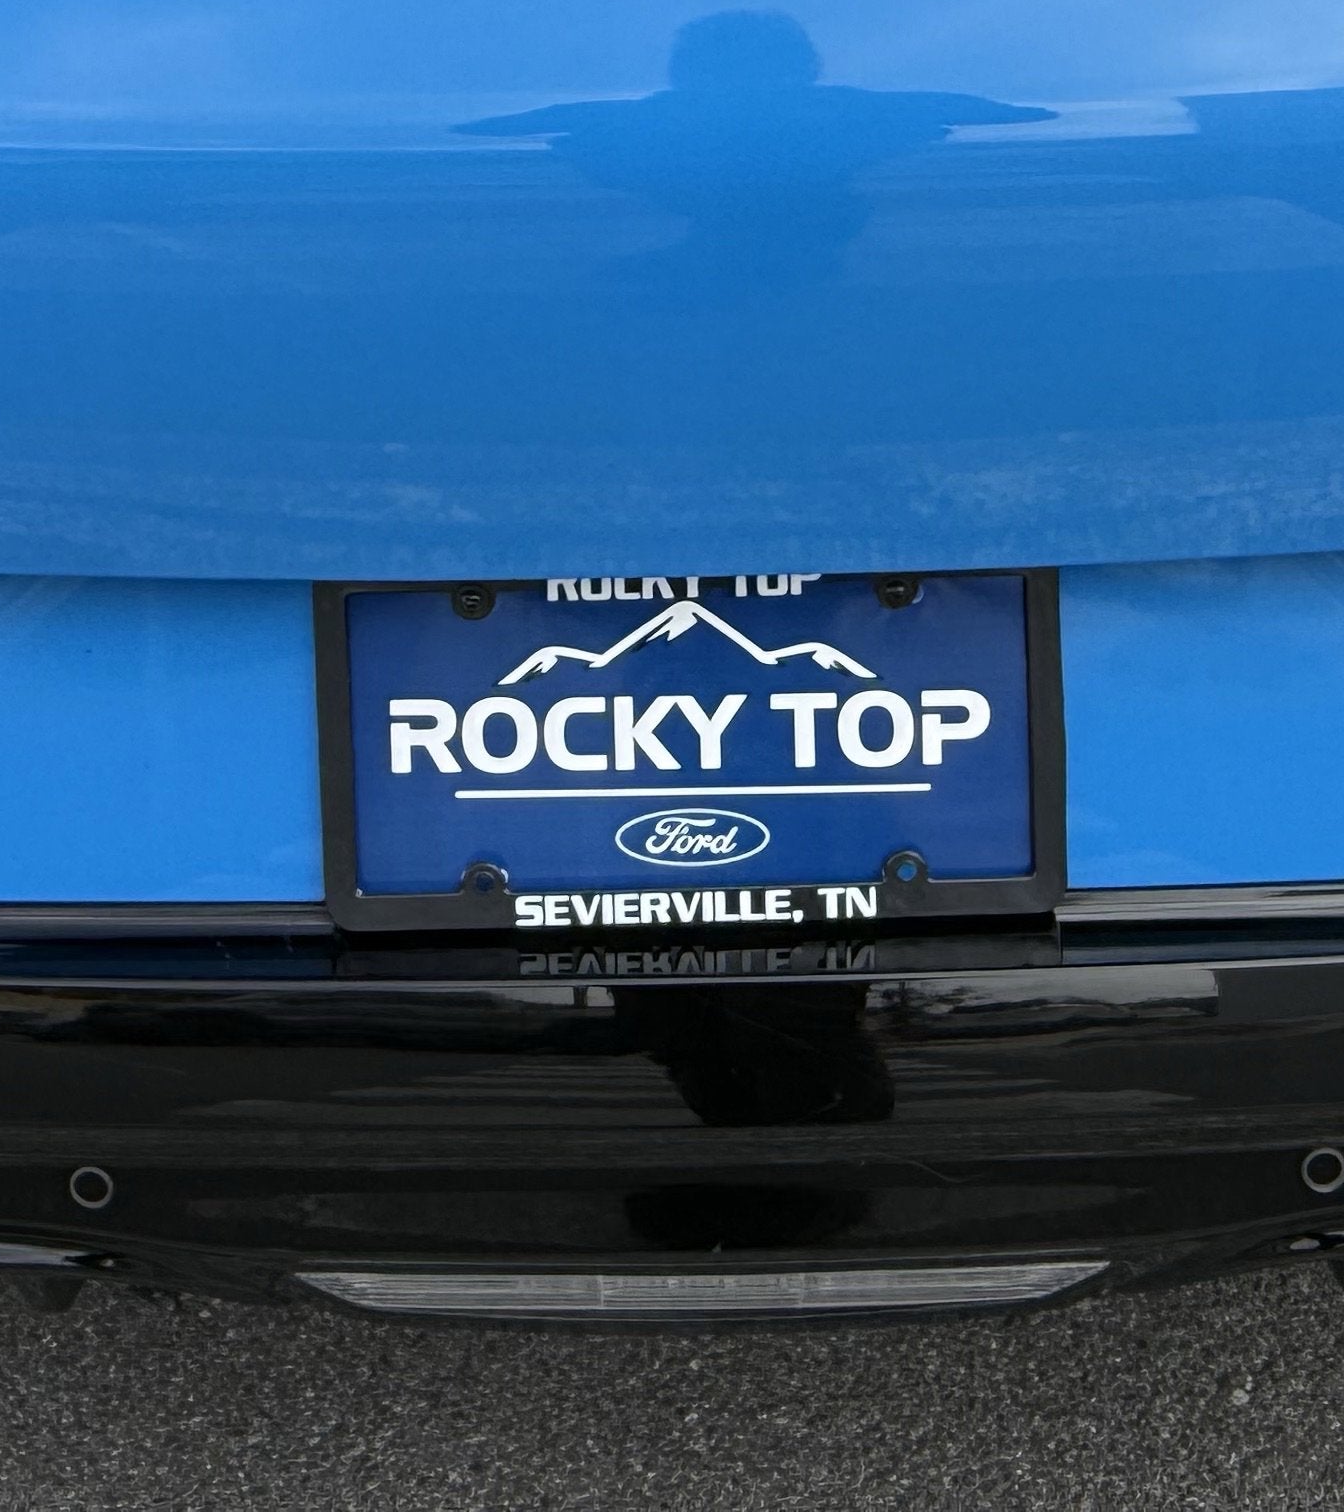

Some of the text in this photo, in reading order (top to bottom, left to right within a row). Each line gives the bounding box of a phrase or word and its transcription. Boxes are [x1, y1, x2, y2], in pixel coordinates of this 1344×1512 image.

[389, 689, 991, 775] ROCKY TOP
[644, 817, 739, 857] Ford
[514, 886, 878, 927] SEVIERVILLE, TN
